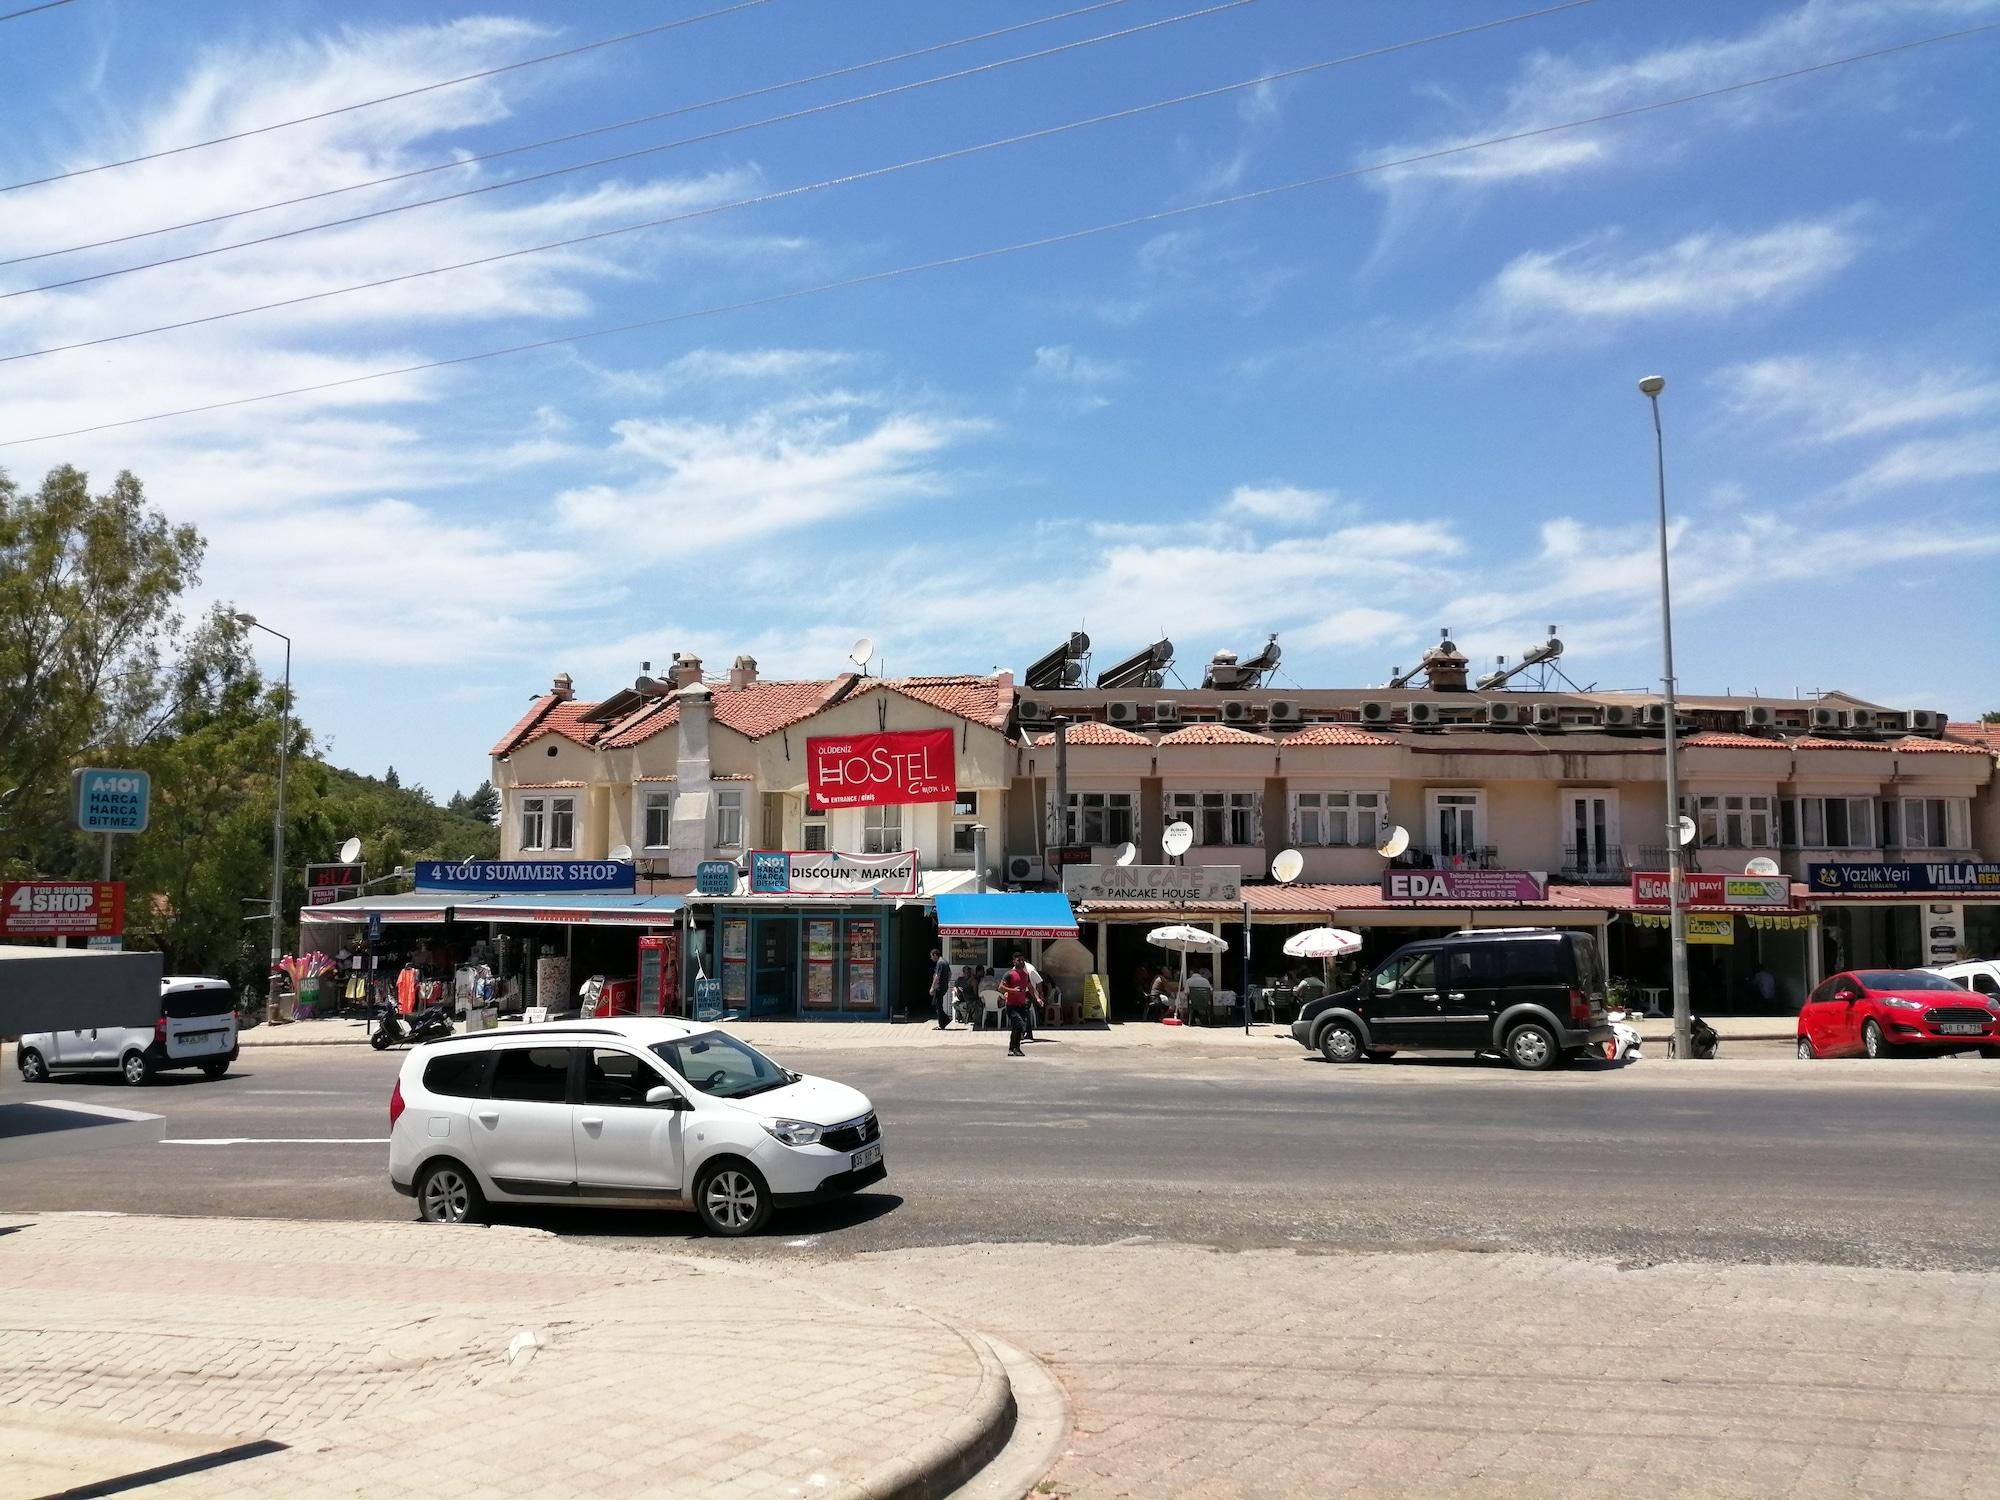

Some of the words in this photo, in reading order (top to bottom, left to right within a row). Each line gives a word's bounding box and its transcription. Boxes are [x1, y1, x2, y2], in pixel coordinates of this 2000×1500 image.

[818, 745, 852, 755] ÖLÜDENİZ
[818, 746, 938, 788] HOSTEL
[908, 781, 938, 794] C'mon
[90, 793, 138, 804] HARCA
[830, 795, 857, 803] ENTRANCE
[90, 804, 137, 815] HARCA
[431, 865, 441, 880] 4
[445, 865, 482, 880] YOU
[485, 865, 565, 880] SUMMER
[569, 865, 618, 880] SHOP
[861, 868, 911, 878] MARKET
[1147, 868, 1204, 888] CAFE
[1841, 867, 1882, 882] Yazlık
[1882, 867, 1910, 882] Yeri
[1391, 876, 1449, 896] EDA
[1728, 882, 1764, 895] iddaa
[10, 886, 32, 912] 4
[1108, 888, 1157, 898] PANCAKE
[1162, 889, 1200, 898] HOUSE
[32, 894, 93, 912] SHOP
[940, 928, 976, 936] GÖZLEME
[1027, 929, 1050, 937] DÜRÜM
[1690, 919, 1717, 934] iddaa
